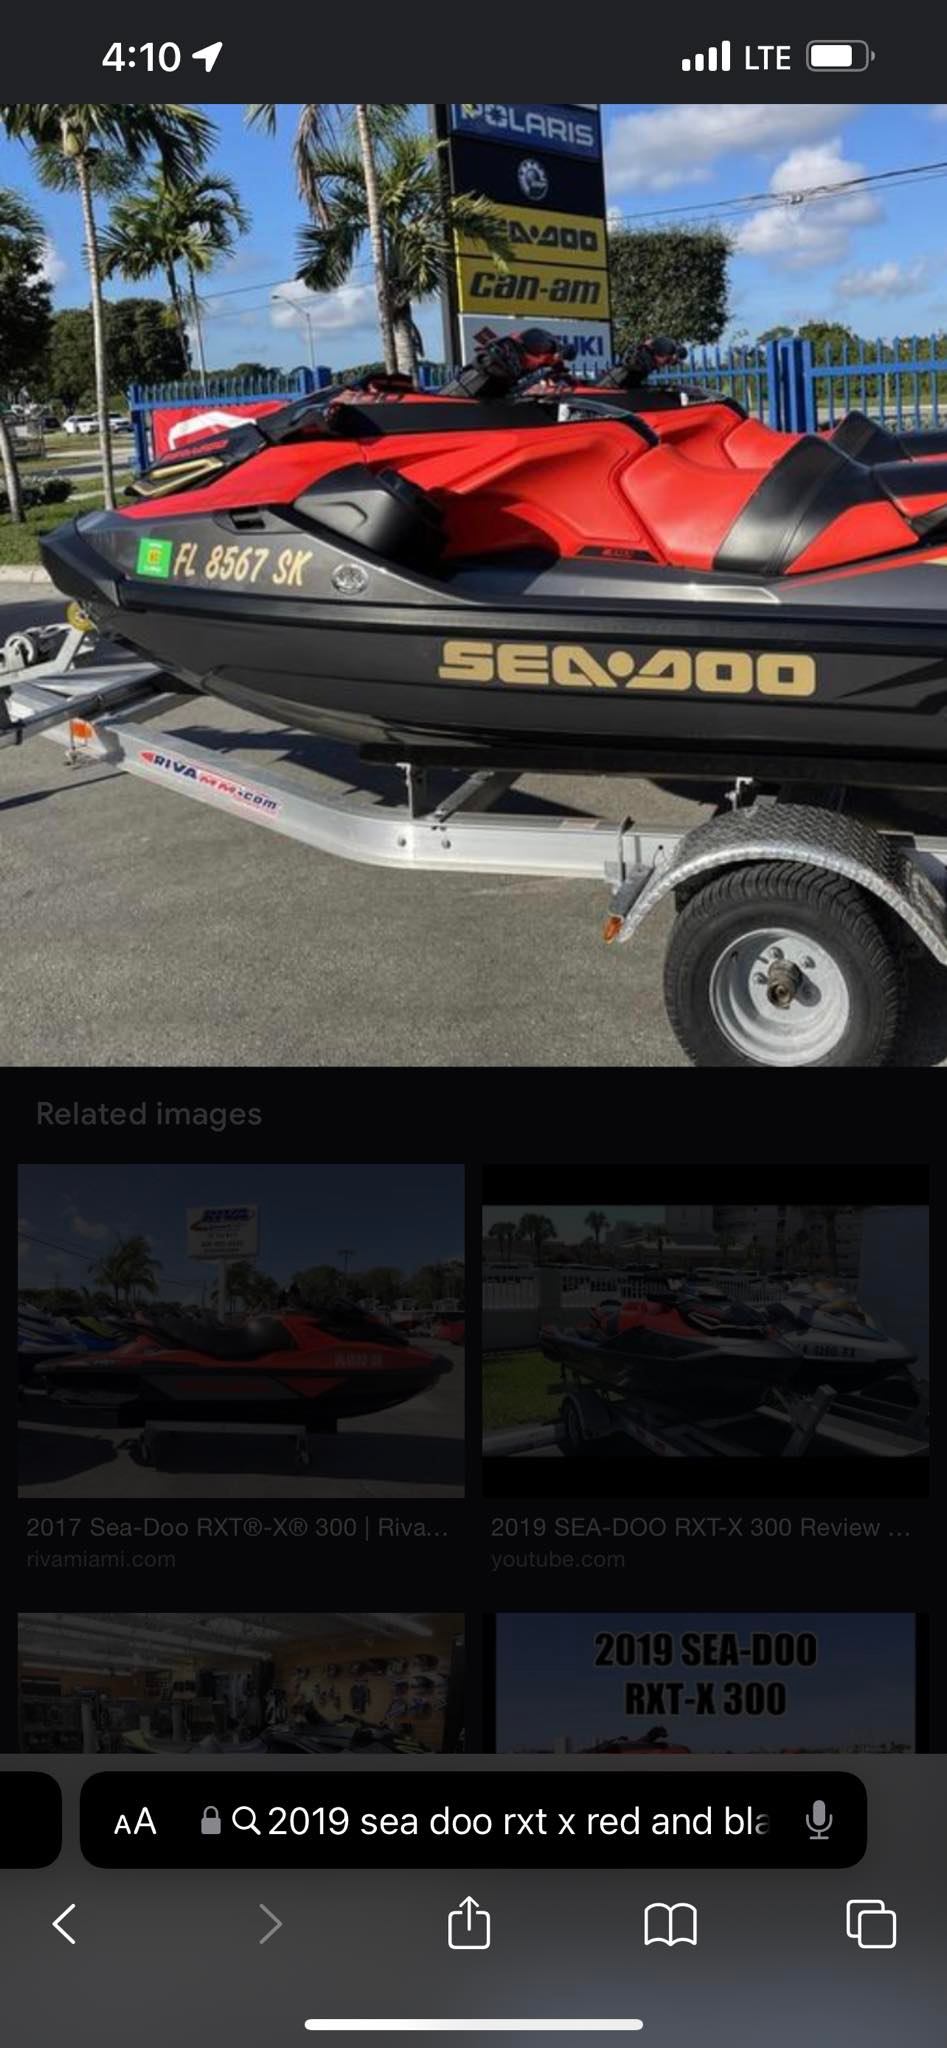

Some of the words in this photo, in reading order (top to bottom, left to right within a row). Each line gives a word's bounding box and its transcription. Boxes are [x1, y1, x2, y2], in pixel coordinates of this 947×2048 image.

[101, 41, 182, 73] 4:10
[745, 45, 791, 71] LTE
[173, 542, 199, 578] FL
[205, 544, 270, 583] 8567
[272, 549, 314, 587] SK
[37, 1100, 147, 1126] Related
[156, 1101, 263, 1133] images
[26, 1517, 82, 1537] 2017
[90, 1516, 189, 1537] Sea-Doo
[315, 1517, 357, 1537] 300
[491, 1517, 546, 1537] 2019
[554, 1517, 667, 1537] SEA-DOO
[675, 1517, 744, 1537] RXT-X
[750, 1517, 792, 1537] 300
[800, 1517, 881, 1537] Review
[27, 1549, 176, 1569] rivamiami.com
[491, 1550, 625, 1572] youtube.com
[595, 1633, 673, 1666] 2019
[681, 1633, 817, 1666] SEA-DOO
[626, 1683, 715, 1715] RXT-X
[724, 1683, 786, 1715] 300
[268, 1806, 349, 1836] 2019
[360, 1813, 418, 1836] sea
[429, 1805, 493, 1836] doo
[504, 1808, 548, 1836] rxt
[557, 1813, 576, 1835] x
[587, 1805, 640, 1836] red
[651, 1805, 712, 1836] and
